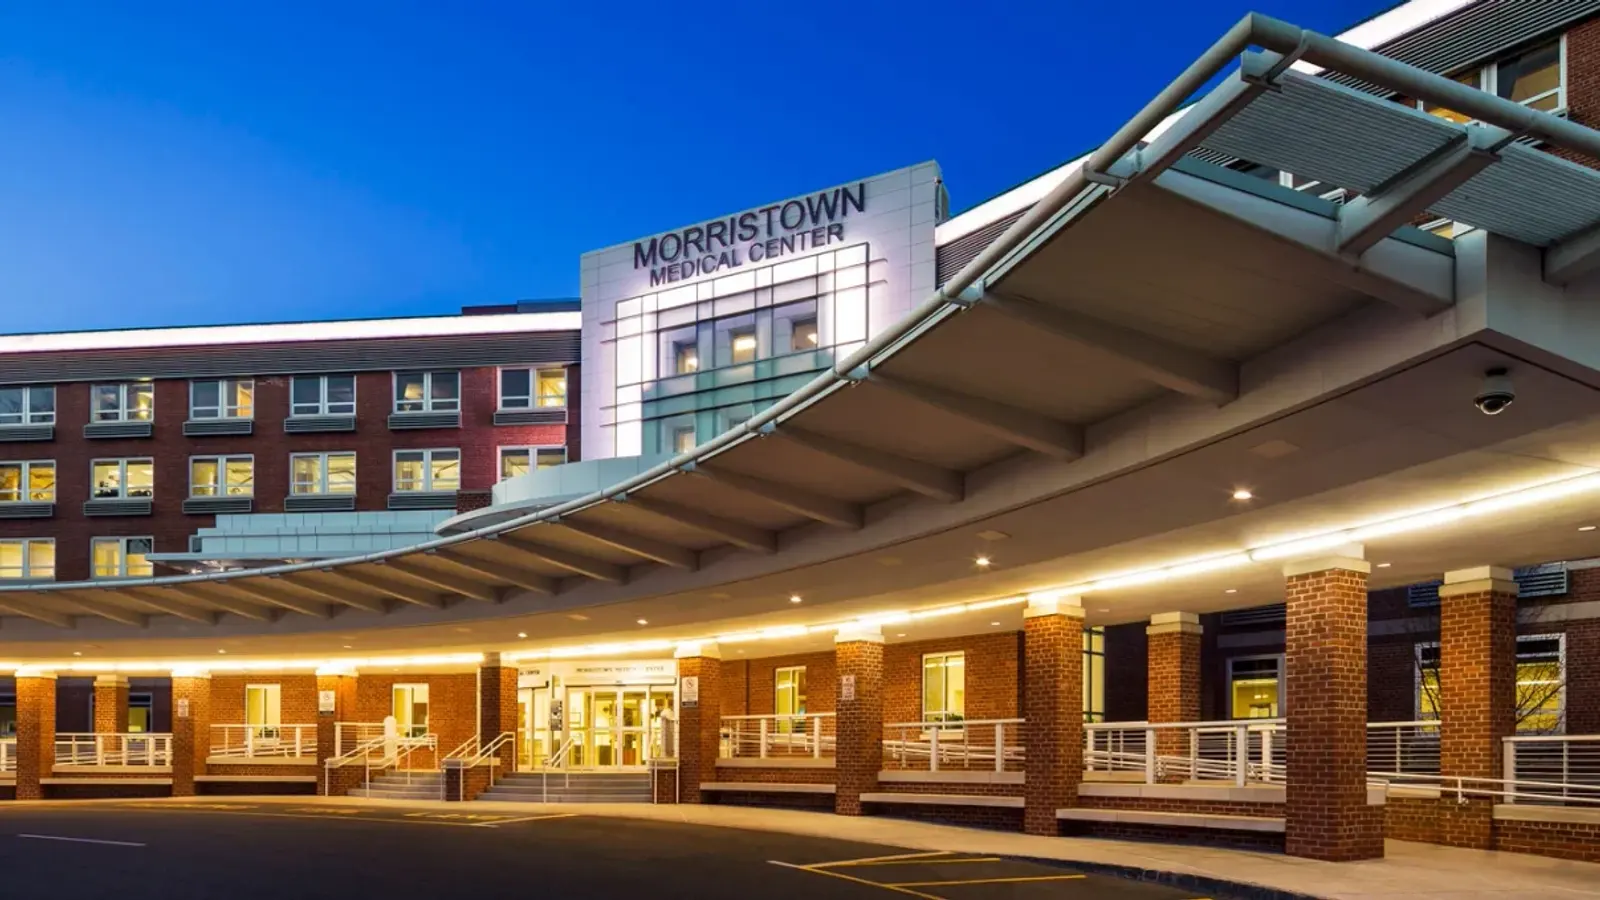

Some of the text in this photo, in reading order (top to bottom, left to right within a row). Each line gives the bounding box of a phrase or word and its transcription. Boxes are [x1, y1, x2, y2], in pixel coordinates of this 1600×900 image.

[633, 182, 865, 269] MORRISTOWN
[650, 223, 844, 287] MEDICAL CENTER
